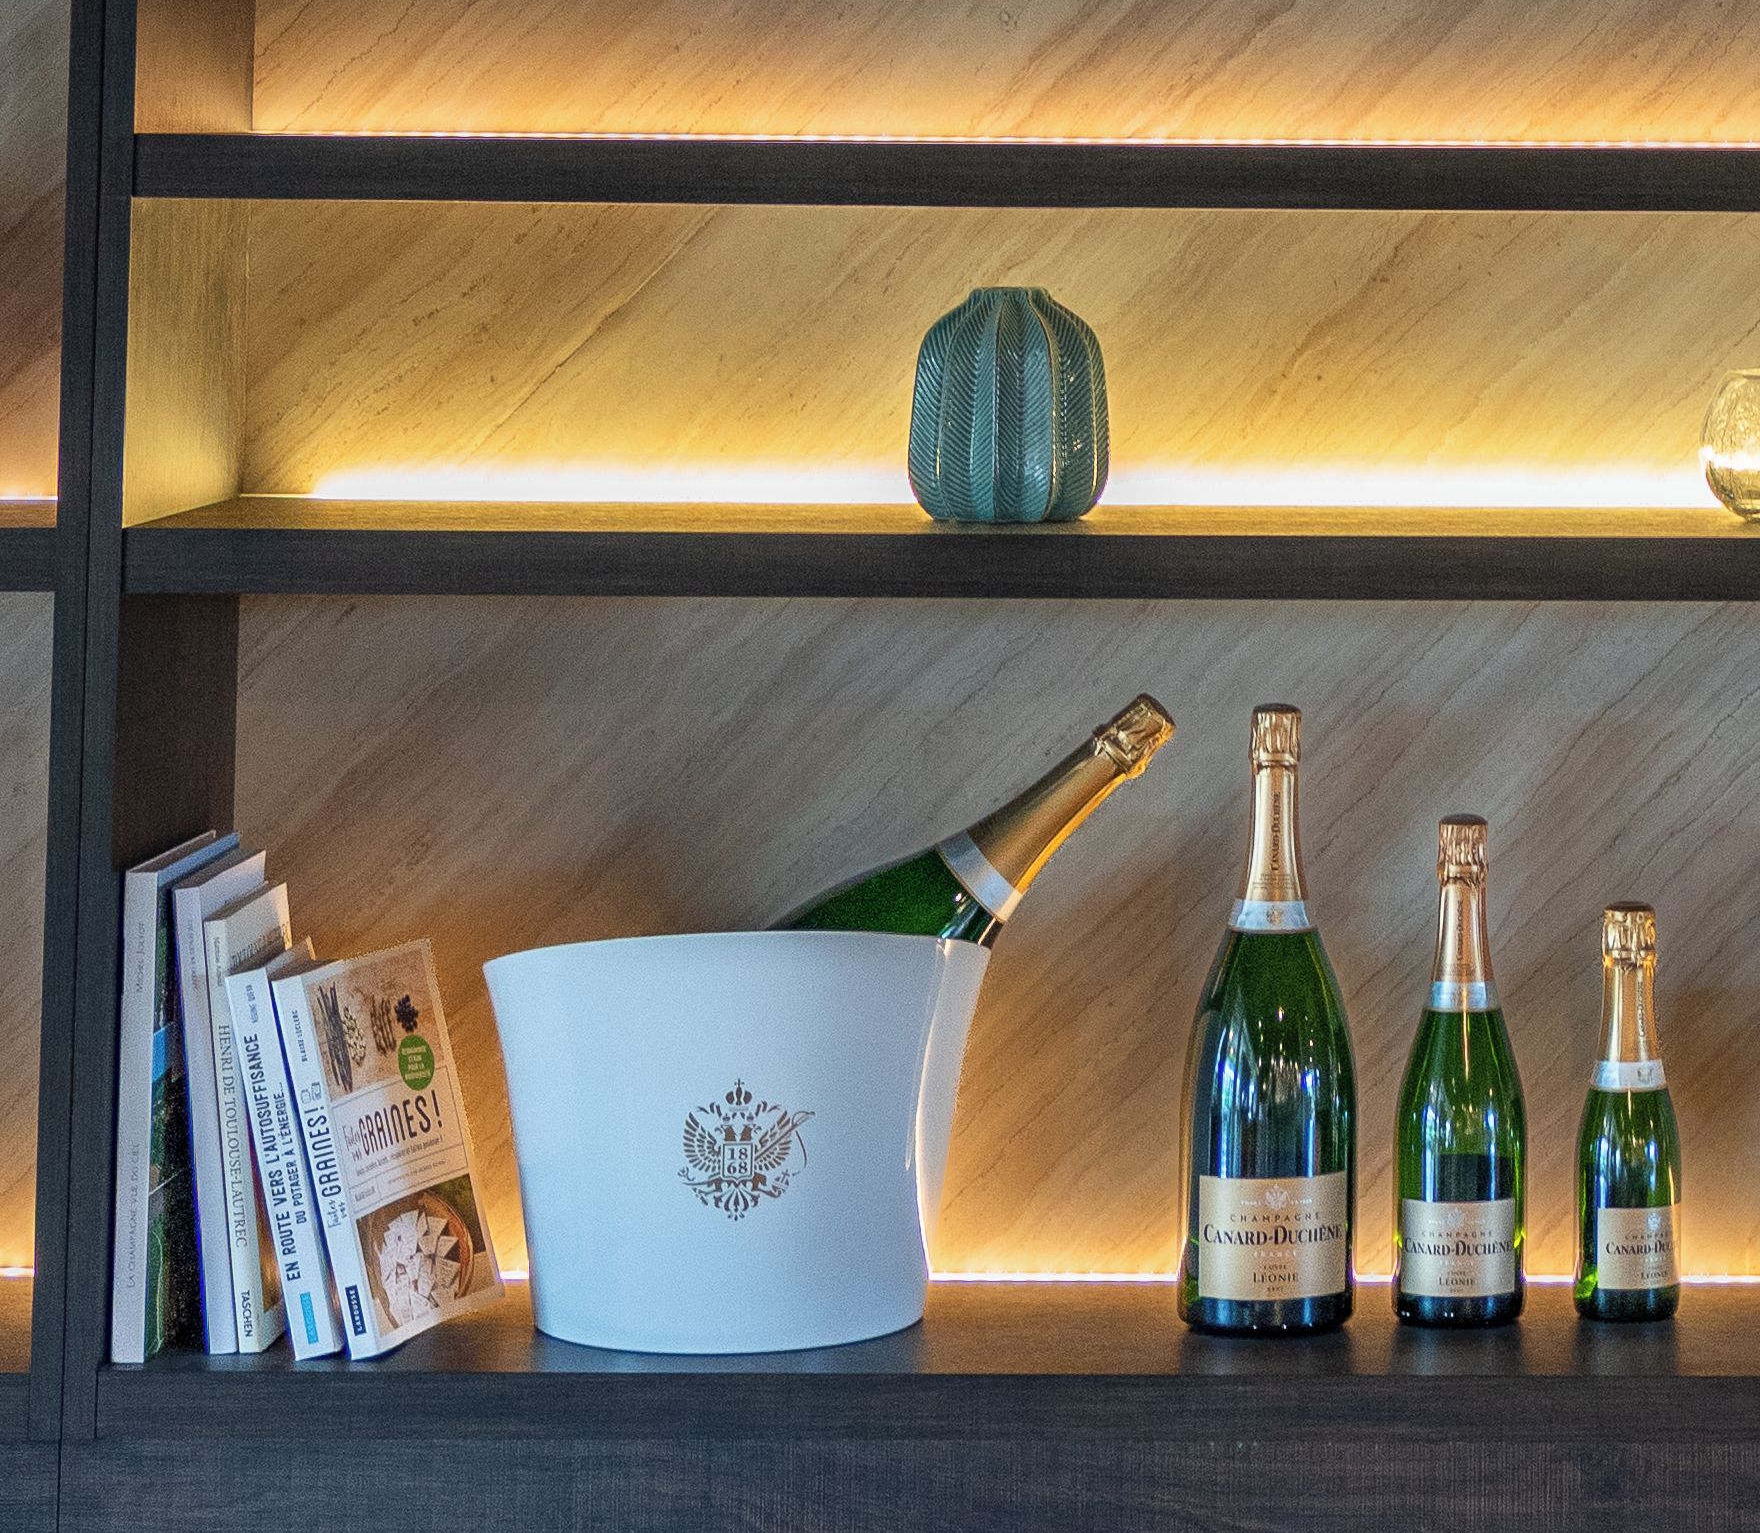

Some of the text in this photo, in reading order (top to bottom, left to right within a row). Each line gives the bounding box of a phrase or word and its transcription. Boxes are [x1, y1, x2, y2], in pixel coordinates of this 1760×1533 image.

[244, 1033, 280, 1165] L'AUTOSUFFISANCE
[218, 1024, 248, 1248] HENRI DE TOULOUSE-LAUTREC
[727, 1147, 748, 1160] 18
[727, 1161, 748, 1174] 68
[268, 1169, 288, 1207] VERS
[287, 1160, 304, 1207] POTAGER
[296, 1207, 307, 1225] DU
[1230, 1212, 1320, 1223] CHAMPAGNE
[275, 1210, 296, 1256] ROUTE
[1203, 1223, 1342, 1246] CANARD-DUCHÊNE
[1404, 1237, 1513, 1256] CANARD-DUCHÊNE
[285, 1260, 301, 1282] EN
[1253, 1270, 1299, 1284] LÉONIE
[241, 1290, 253, 1337] TASCHEN
